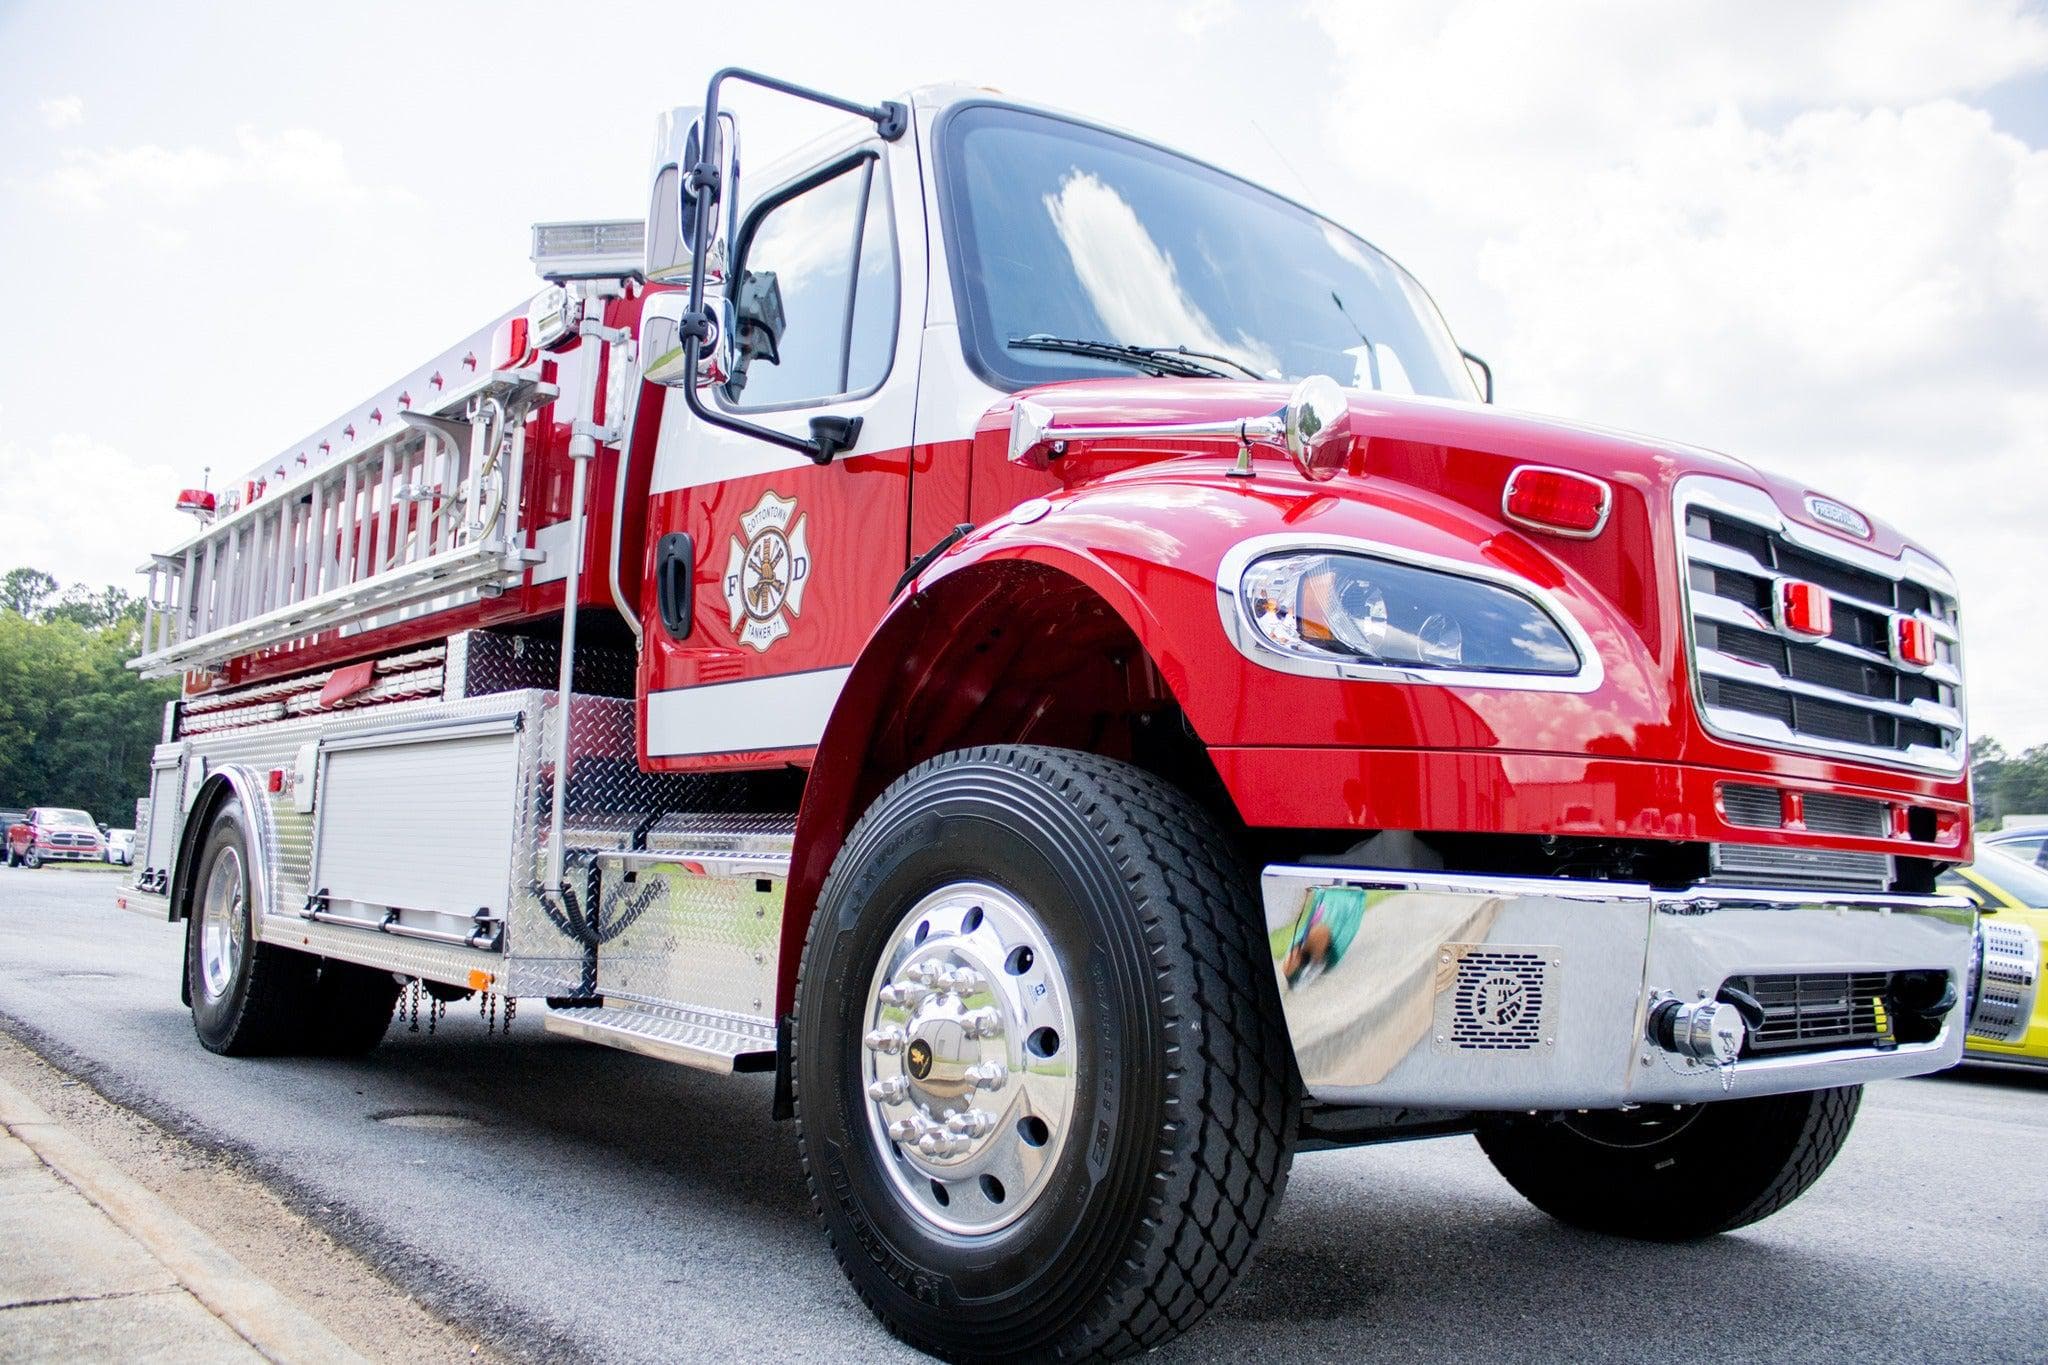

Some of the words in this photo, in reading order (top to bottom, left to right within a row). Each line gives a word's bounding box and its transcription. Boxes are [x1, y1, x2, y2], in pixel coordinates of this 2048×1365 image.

[747, 506, 787, 533] COTTONTOWN
[728, 575, 738, 597] F
[793, 557, 806, 581] D
[748, 623, 772, 639] TANKER
[876, 822, 925, 864] WORKS
[830, 1163, 911, 1289] MICHELIN
